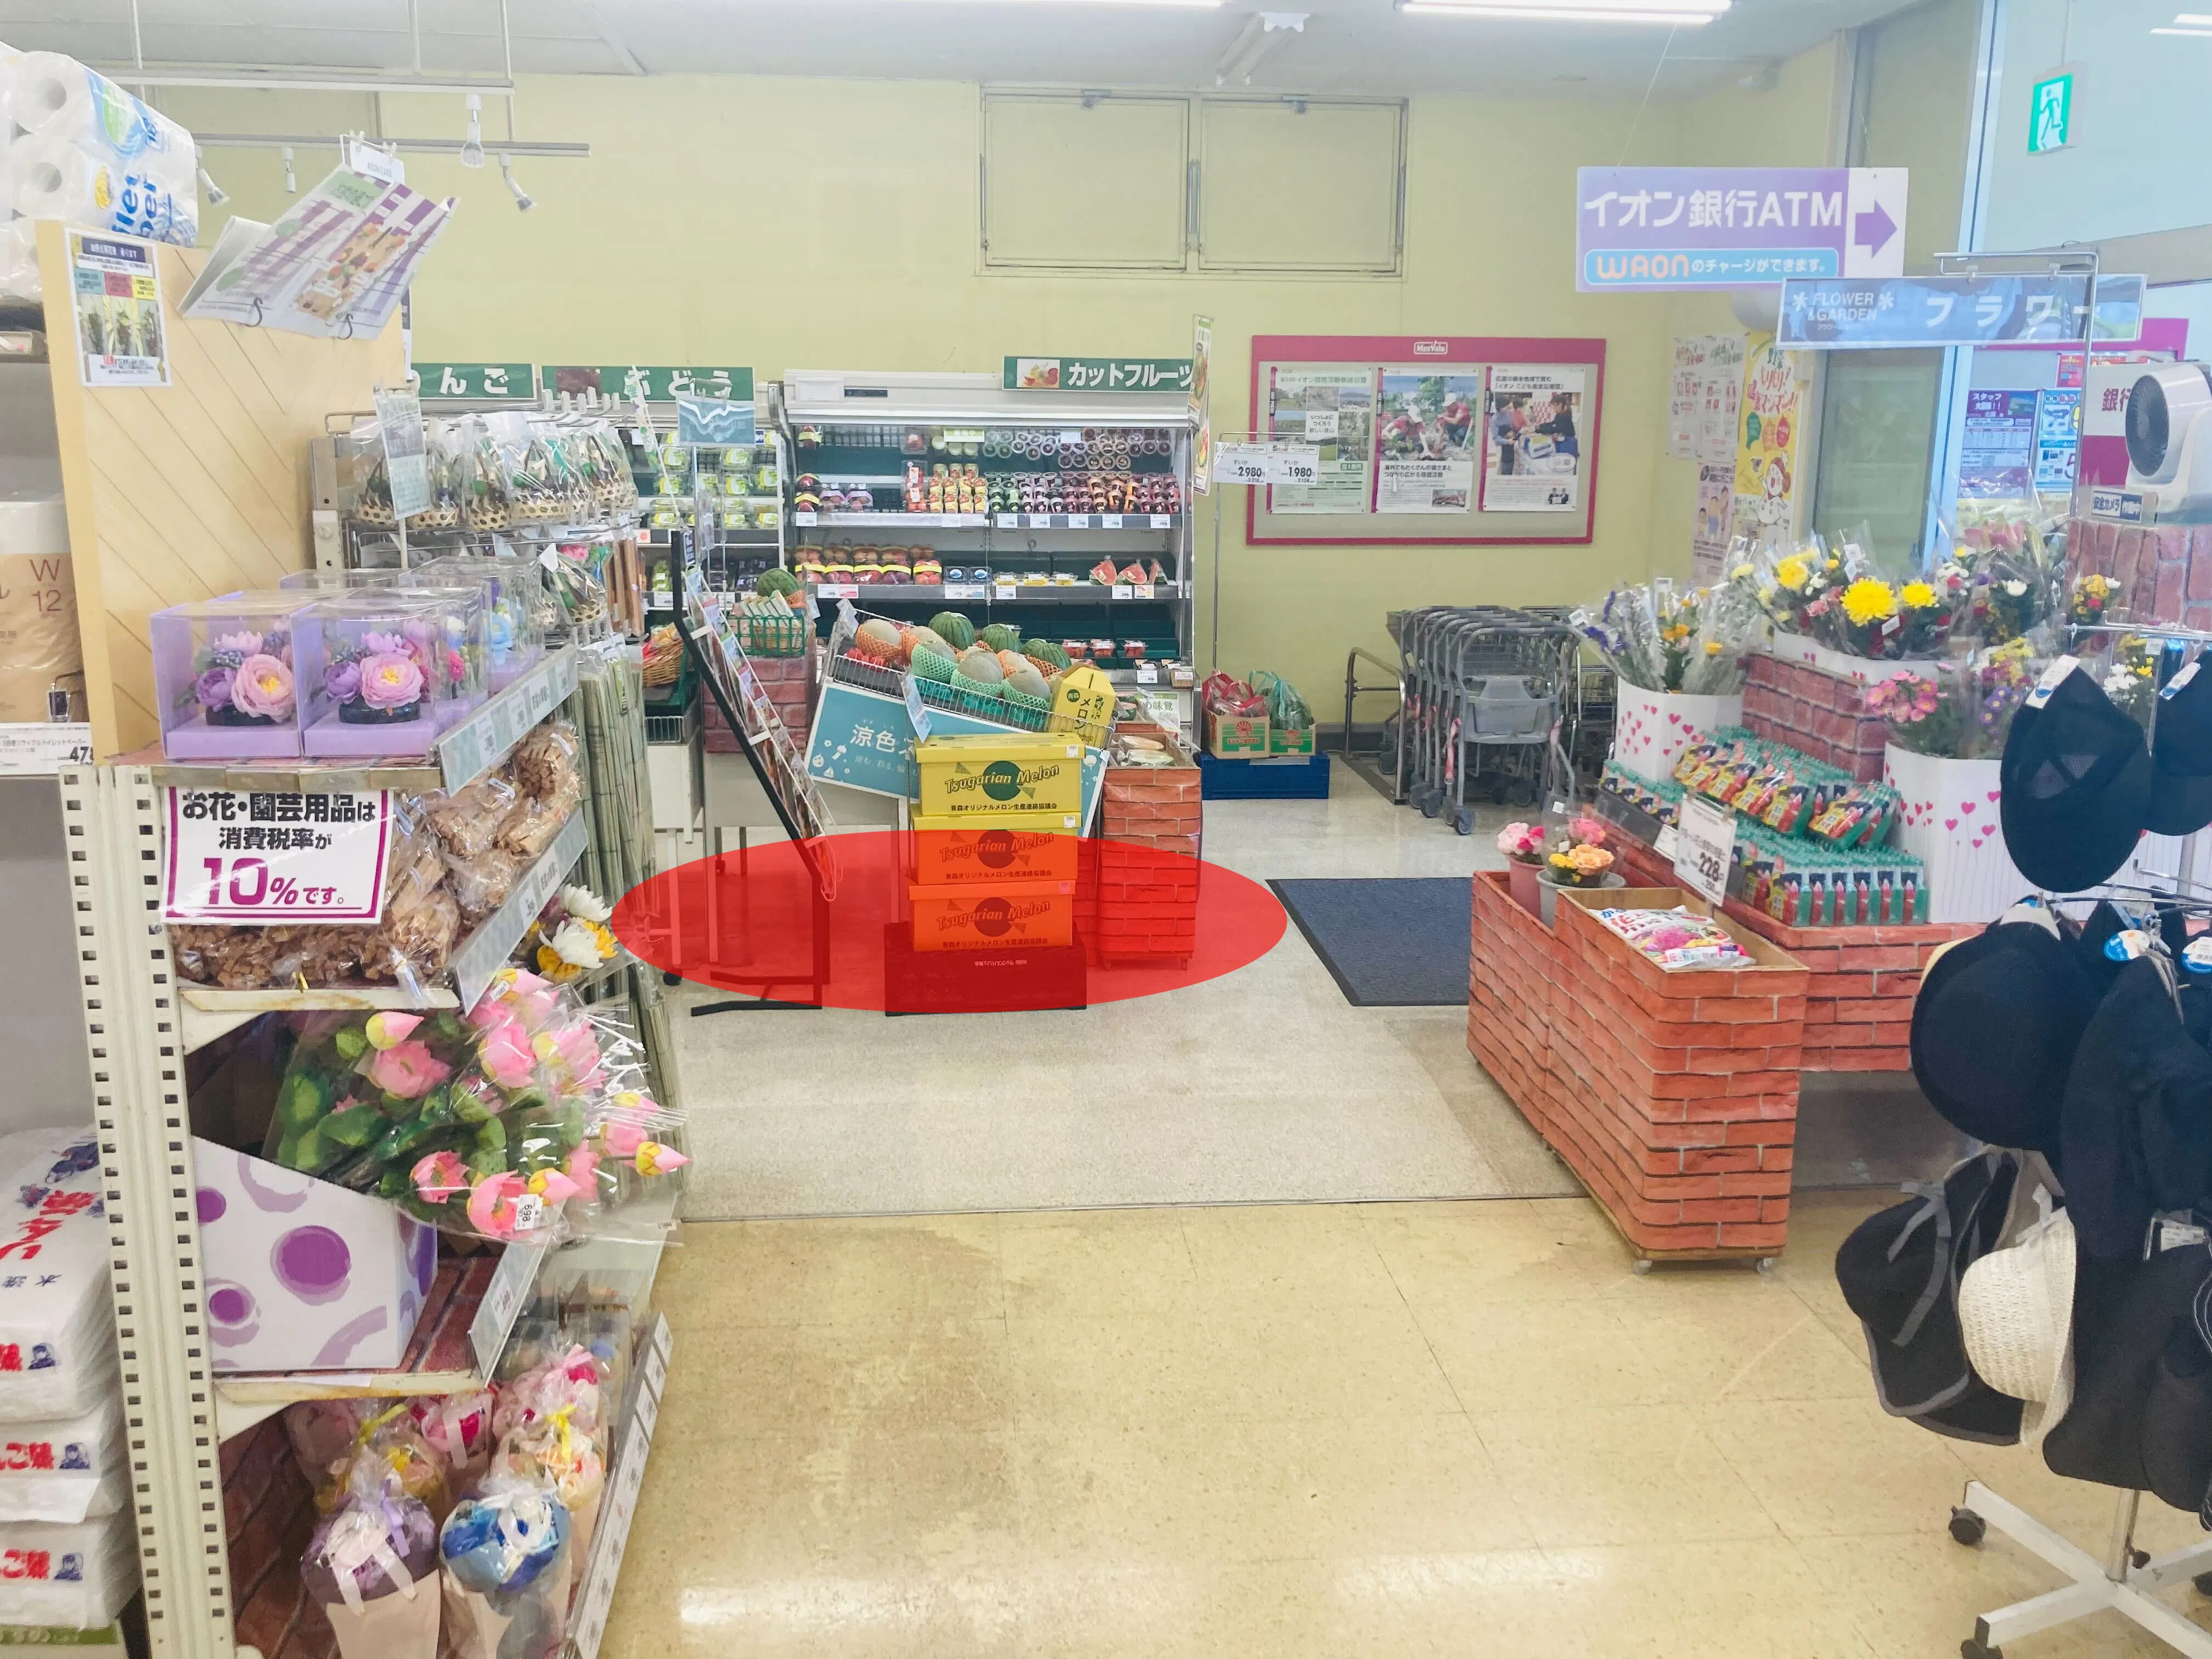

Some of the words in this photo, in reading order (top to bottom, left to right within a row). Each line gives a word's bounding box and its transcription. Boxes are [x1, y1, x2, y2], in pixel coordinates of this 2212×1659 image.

[1584, 190, 1843, 228] イオン銀行ATM
[1597, 255, 1689, 279] WAON
[1691, 258, 1825, 273] のチャージができます。
[1813, 292, 1874, 306] FLOWER
[1808, 308, 1877, 321] &GARDEN
[1926, 295, 2101, 328] フラワー
[1417, 340, 1446, 352] MaxValu
[1068, 360, 1193, 388] カットフルーツ
[1975, 401, 2001, 410] 大!!
[29, 558, 60, 582] W
[32, 590, 63, 612] 12
[945, 771, 1012, 794] Tsugarian
[1017, 765, 1059, 786] Melon
[182, 792, 376, 823] お花・園芸用品は
[951, 803, 1057, 811] 青森オリジナルメロン生産連絡協議会
[219, 827, 332, 851] 消費税率が
[940, 839, 1006, 862] Tsugarian
[1011, 832, 1054, 853] Melon
[936, 908, 1003, 931] Tsugarian
[1007, 900, 1051, 921] Melon
[522, 1204, 533, 1222] 698
